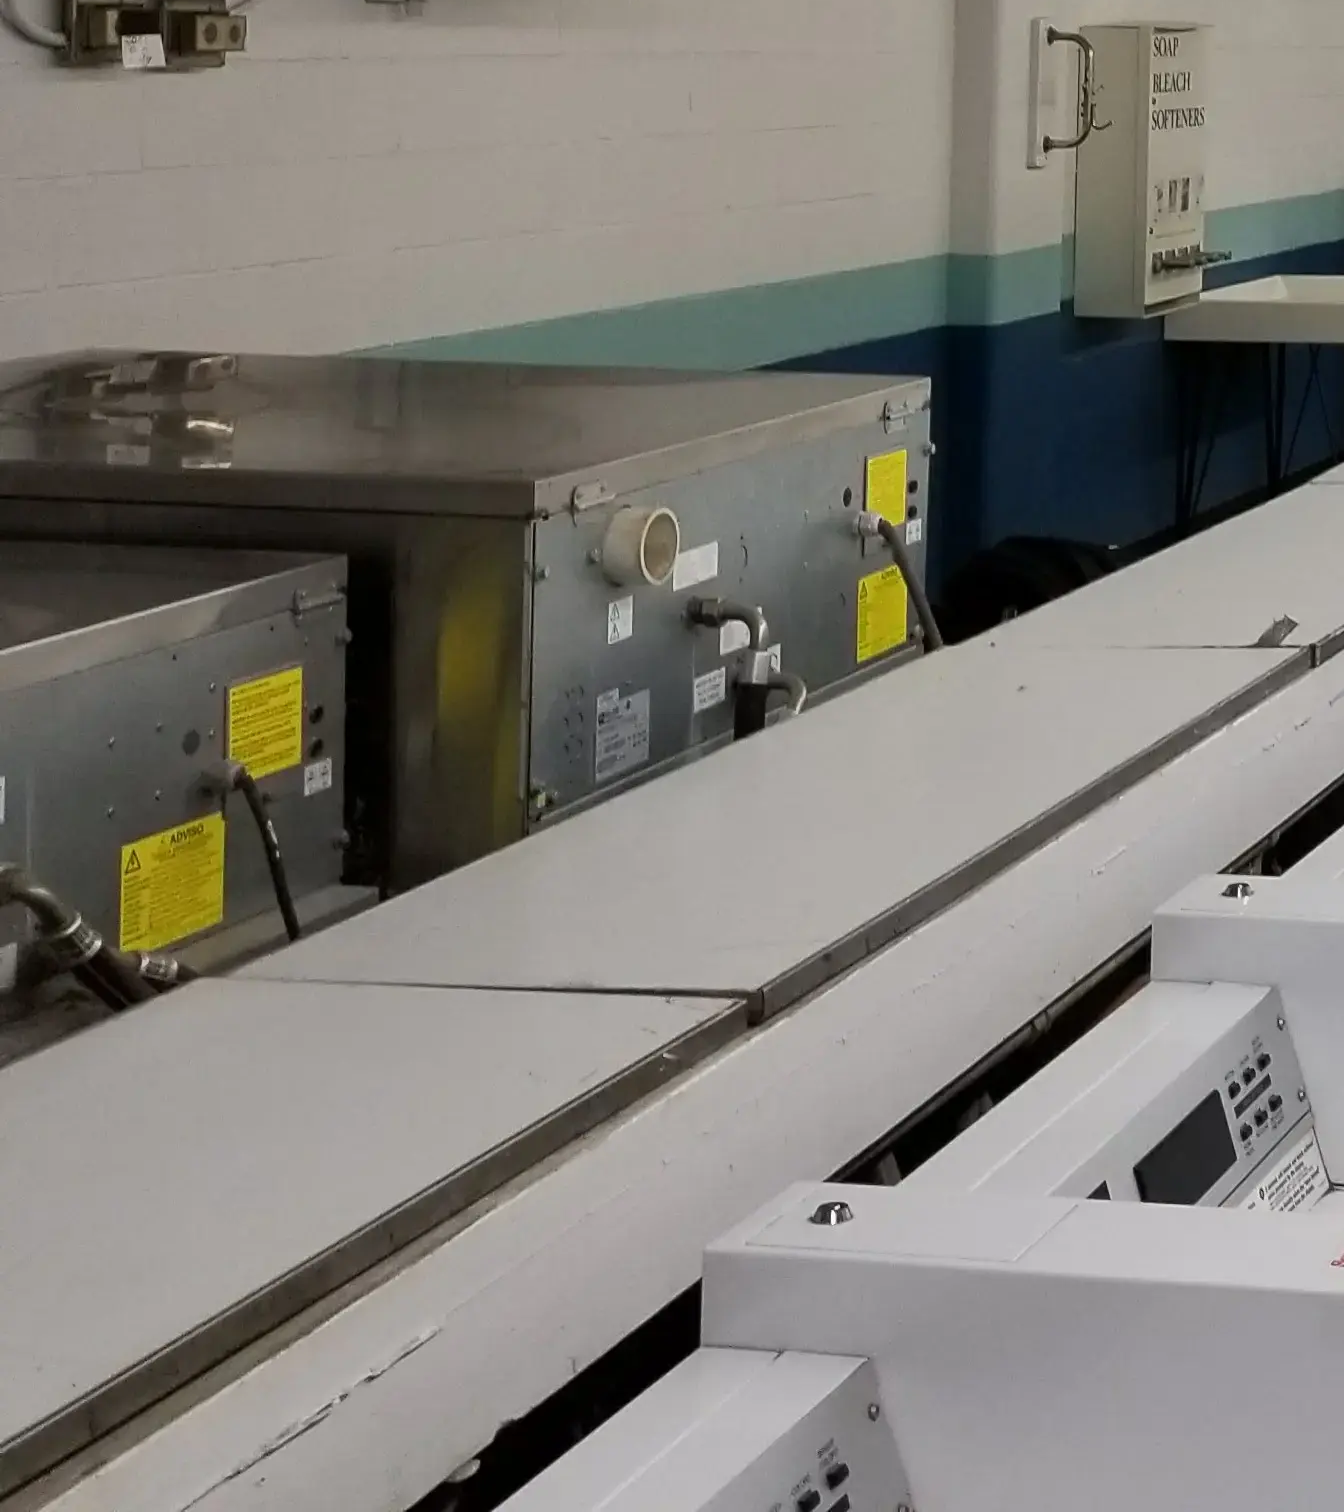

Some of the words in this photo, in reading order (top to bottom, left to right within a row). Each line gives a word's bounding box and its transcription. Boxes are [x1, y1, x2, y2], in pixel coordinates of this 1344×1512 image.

[1153, 36, 1179, 57] SOAP
[1153, 71, 1191, 93] BLEACH
[1151, 107, 1205, 130] SOFTENERS
